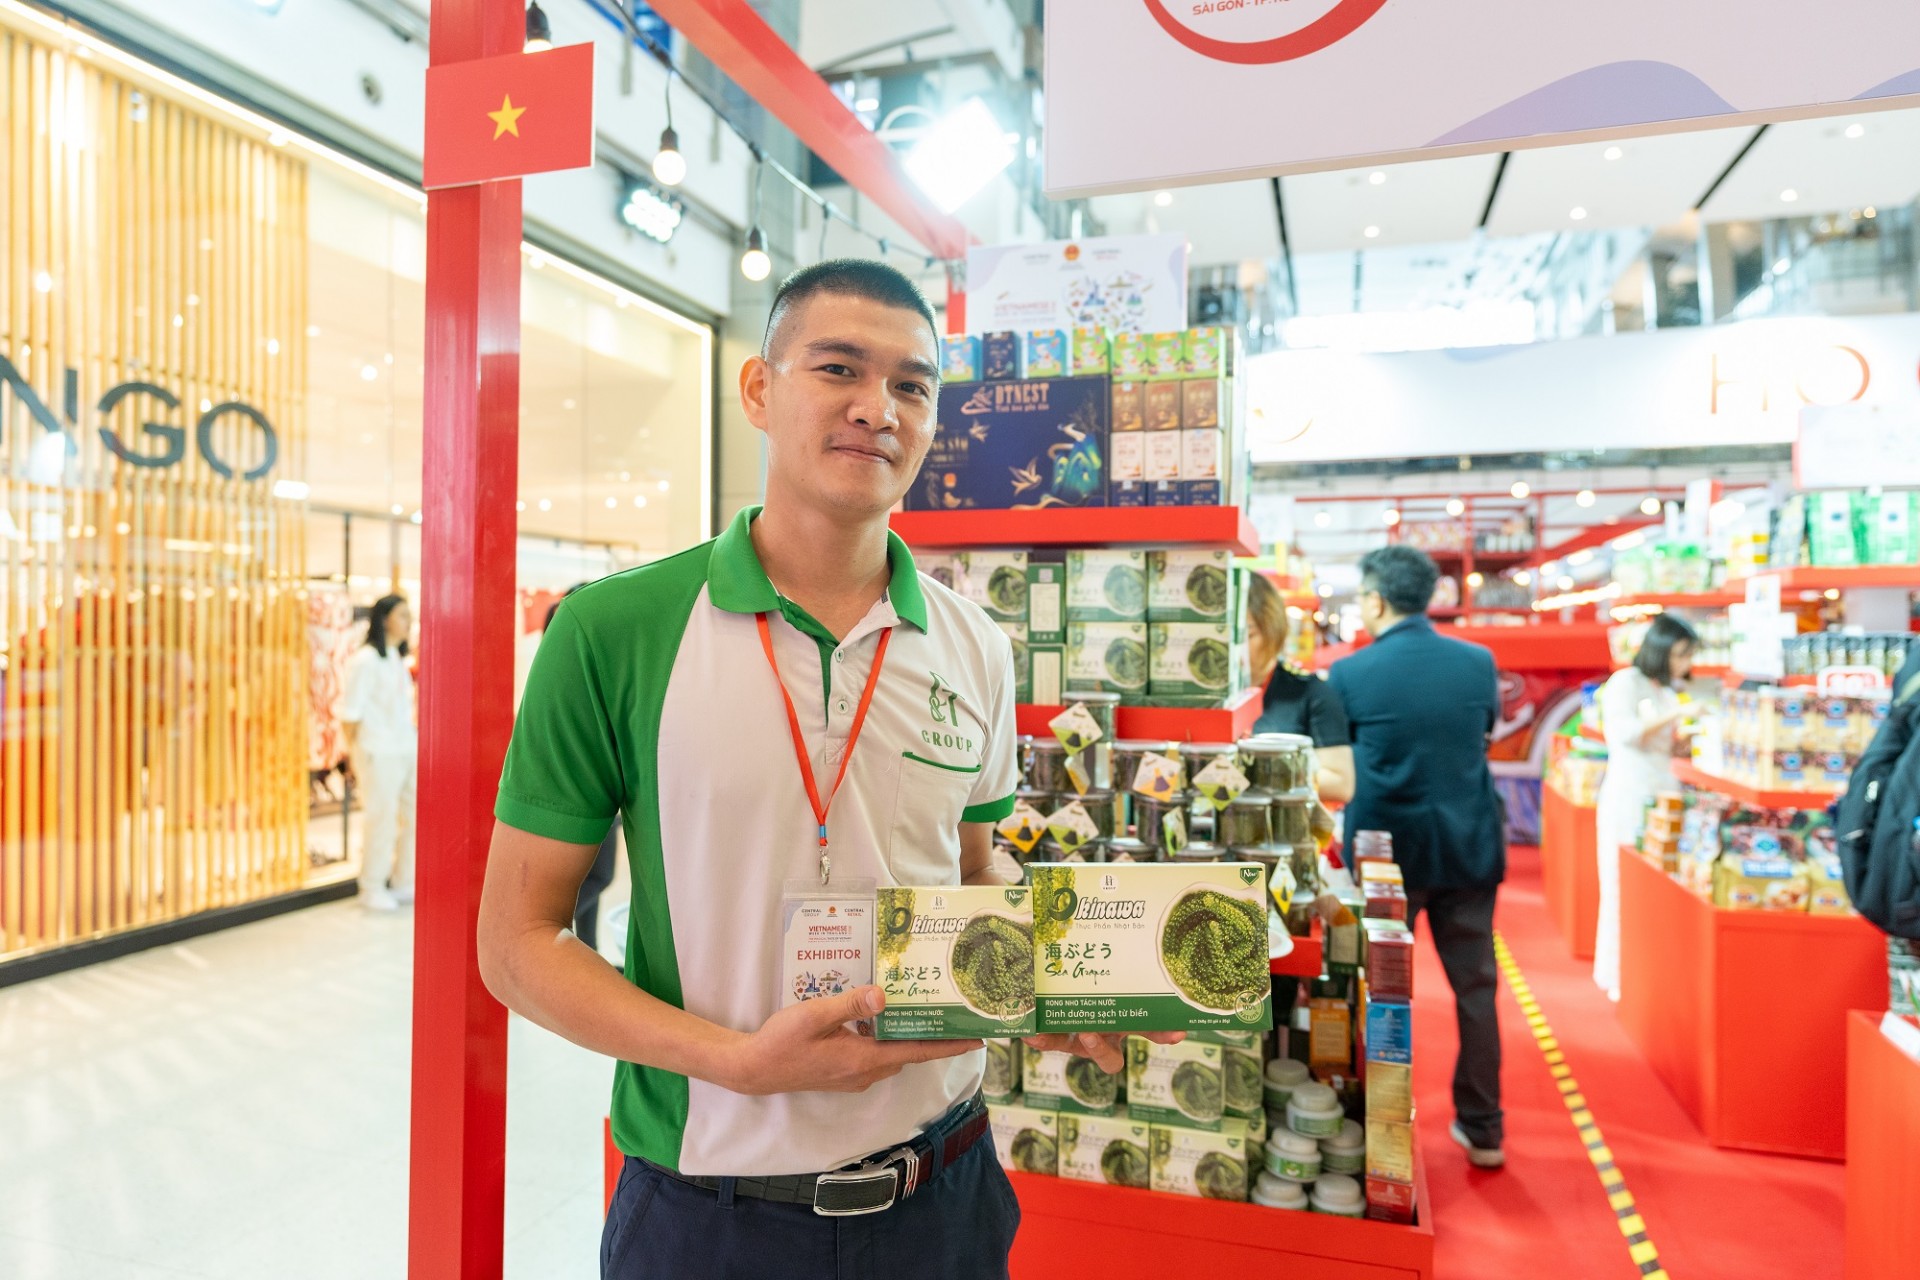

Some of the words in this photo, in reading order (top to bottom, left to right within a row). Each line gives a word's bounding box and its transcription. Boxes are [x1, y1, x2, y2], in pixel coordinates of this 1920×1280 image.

[921, 729, 973, 753] GROUP
[1047, 886, 1146, 921] Okinawa
[887, 906, 968, 935] Okinawa
[797, 949, 861, 960] EXHIBITOR
[1045, 942, 1112, 960] 海ぶどう
[885, 966, 942, 981] 海ぶどう
[1044, 962, 1068, 977] Sea
[884, 983, 904, 995] Sea
[1097, 998, 1117, 1006] NƯỚC
[1045, 1009, 1066, 1018] Dinh
[1067, 1009, 1096, 1020] dưỡng
[1097, 1009, 1117, 1019] sạch
[1118, 1008, 1128, 1017] từ
[1129, 1007, 1149, 1017] biển
